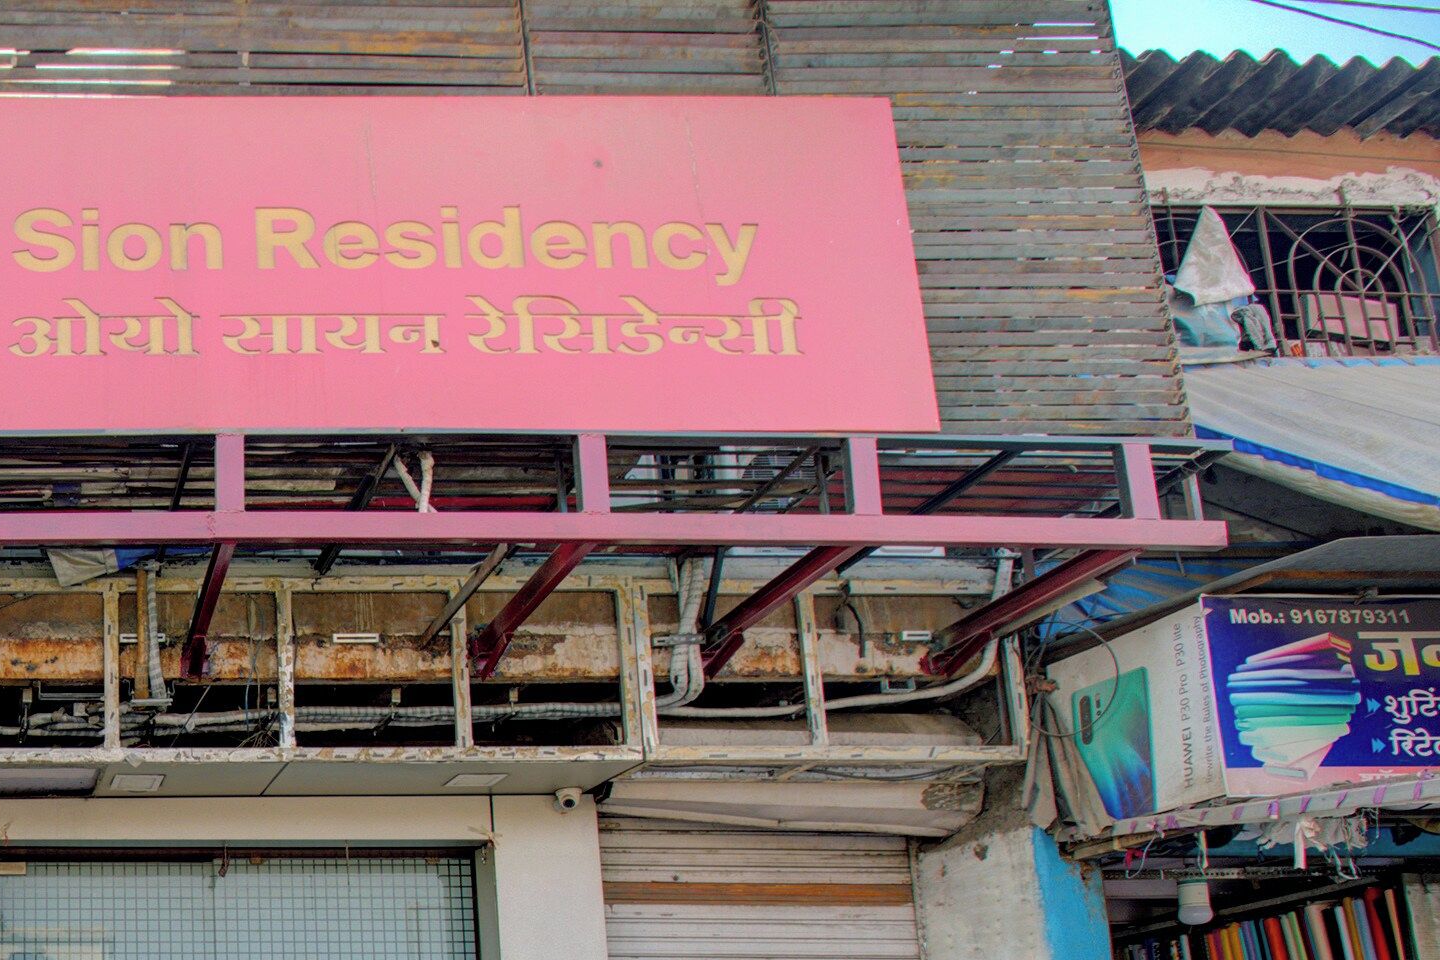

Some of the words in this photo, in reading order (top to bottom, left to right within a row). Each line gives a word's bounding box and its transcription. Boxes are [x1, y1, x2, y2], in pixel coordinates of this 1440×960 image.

[12, 207, 224, 272] Sion
[255, 204, 759, 286] Residency
[8, 297, 201, 357] ओयो
[219, 313, 447, 355] सायन
[464, 294, 805, 356] रेसिडेन्सी
[1289, 608, 1410, 624] 9167879311
[1173, 623, 1183, 642] lite
[1174, 643, 1185, 667] P30
[1193, 615, 1209, 681] Photography
[1179, 673, 1192, 696] Pro
[1200, 682, 1210, 694] of
[1180, 697, 1191, 722] P30
[1202, 695, 1212, 724] Rules
[1384, 687, 1440, 725] शुटिं
[1202, 725, 1211, 743] the
[1180, 726, 1193, 789] HUAWEI
